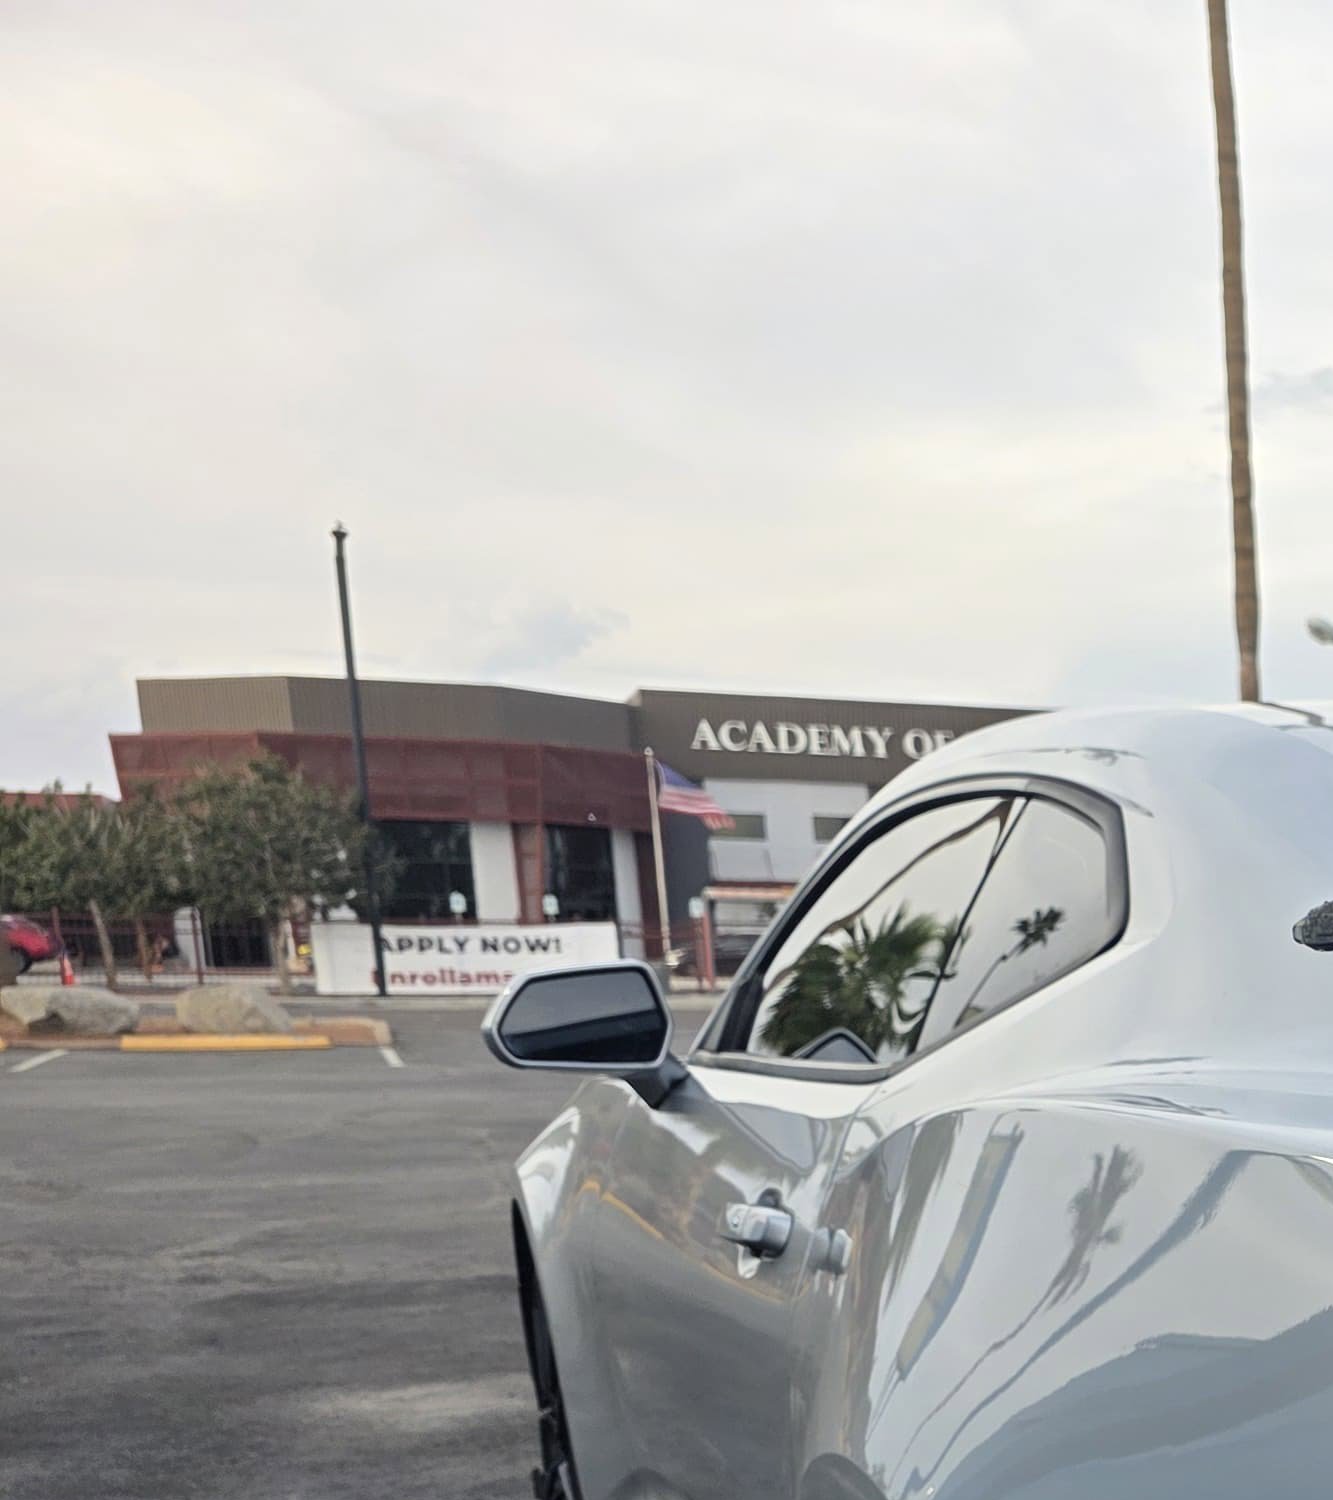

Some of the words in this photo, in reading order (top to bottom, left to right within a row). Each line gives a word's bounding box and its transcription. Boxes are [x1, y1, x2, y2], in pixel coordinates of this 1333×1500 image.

[690, 718, 894, 758] ACADEMY
[379, 935, 470, 954] APPLY
[480, 935, 563, 954] NOW!
